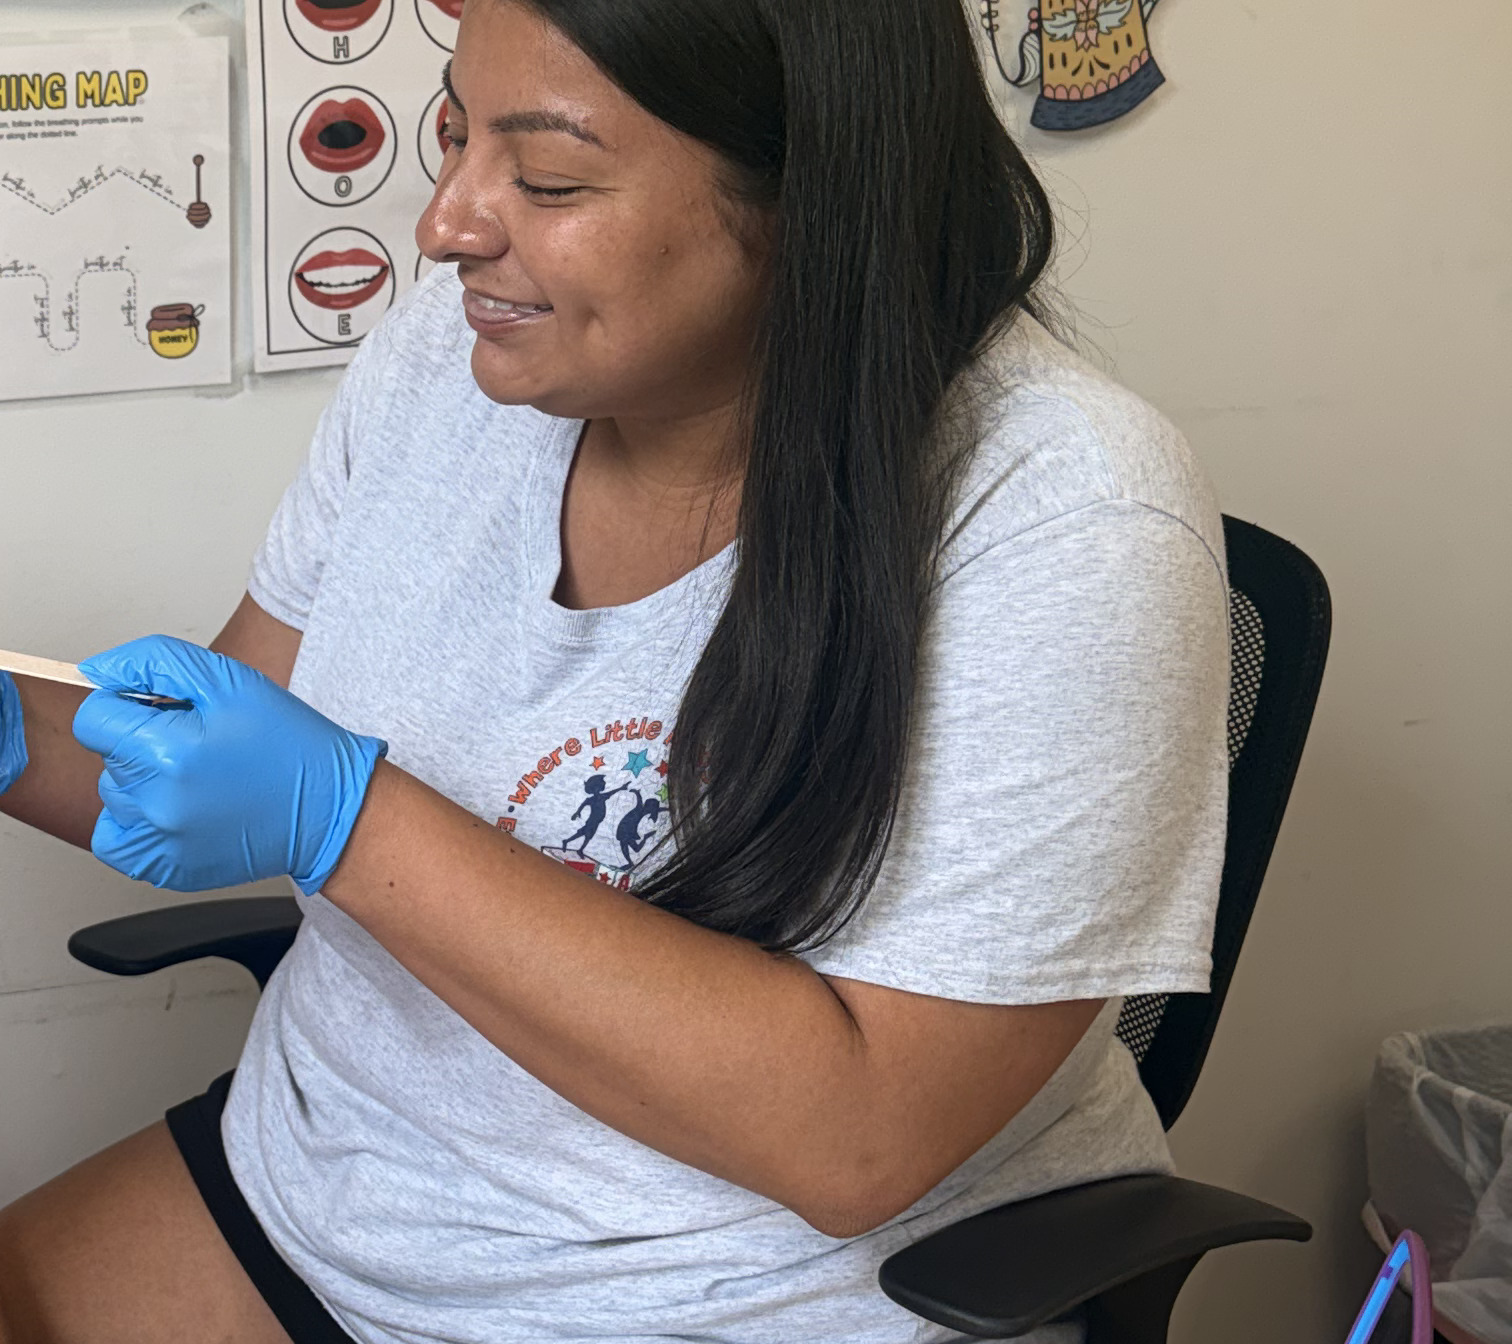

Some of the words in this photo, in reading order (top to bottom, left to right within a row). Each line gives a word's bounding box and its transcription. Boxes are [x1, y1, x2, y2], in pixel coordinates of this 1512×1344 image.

[332, 36, 350, 59] H
[76, 69, 148, 107] MAP
[334, 175, 352, 198] O
[338, 313, 351, 336] E
[507, 737, 582, 805] Where
[590, 716, 663, 749] Little
